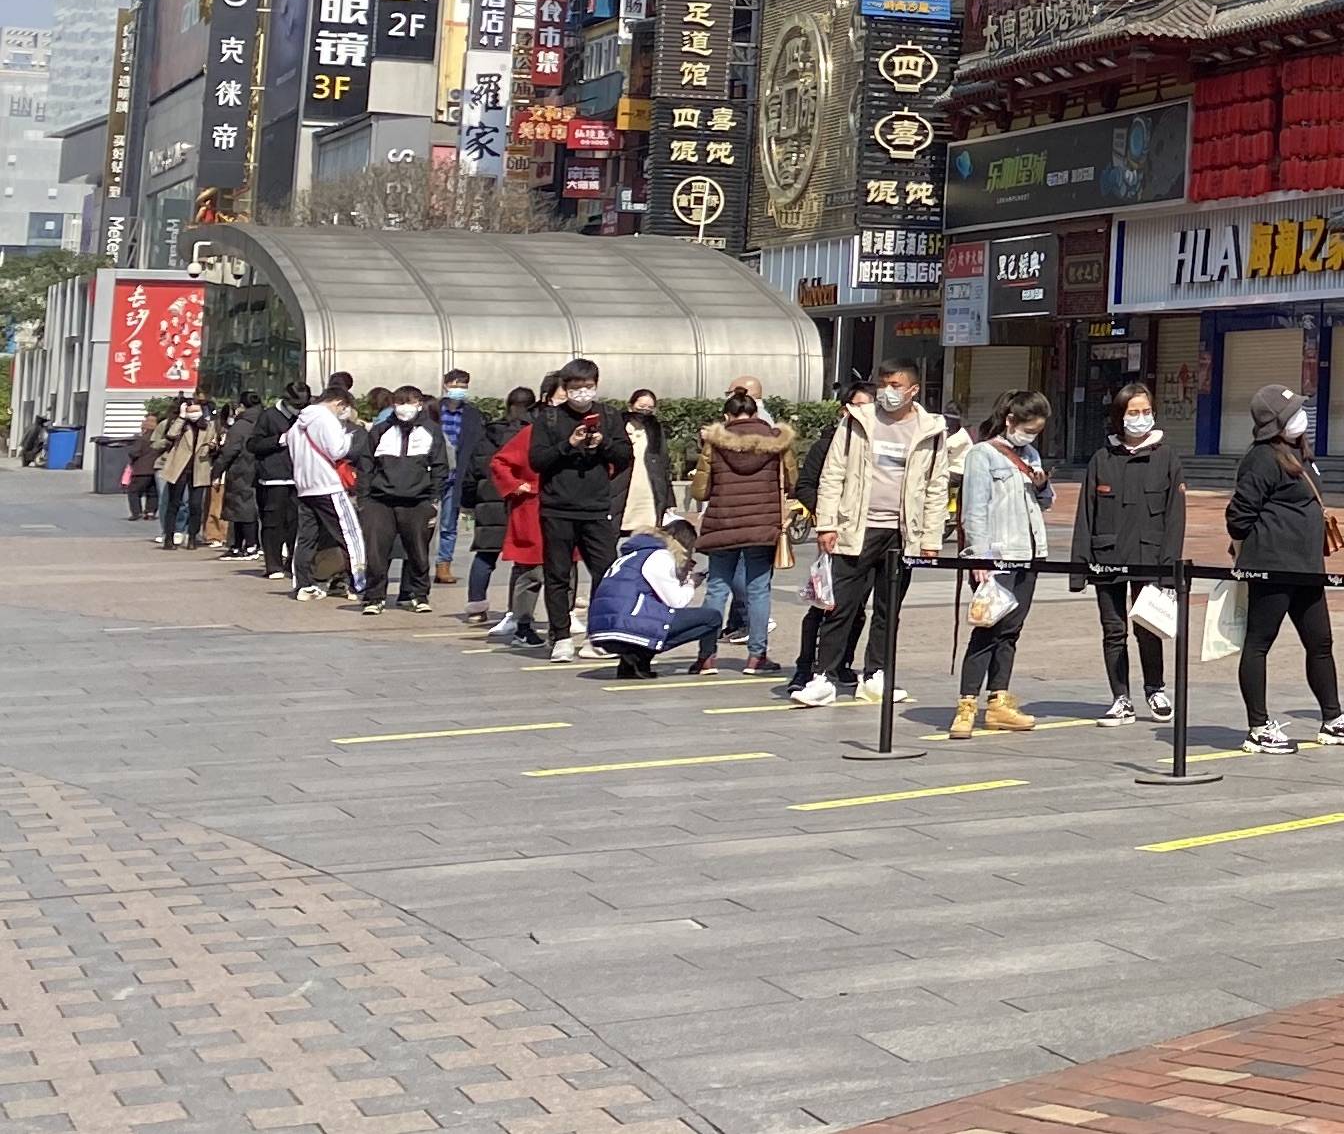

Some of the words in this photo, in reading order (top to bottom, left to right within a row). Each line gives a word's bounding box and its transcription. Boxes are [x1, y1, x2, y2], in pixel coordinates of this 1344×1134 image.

[388, 12, 426, 38] 2F
[212, 36, 246, 150] 克徕帝
[312, 74, 351, 100] 3F
[465, 73, 503, 162] 羅家
[672, 107, 737, 131] 四喜
[670, 140, 735, 165] 馄饨
[867, 179, 935, 205] 馄饨
[1170, 223, 1241, 285] HLA
